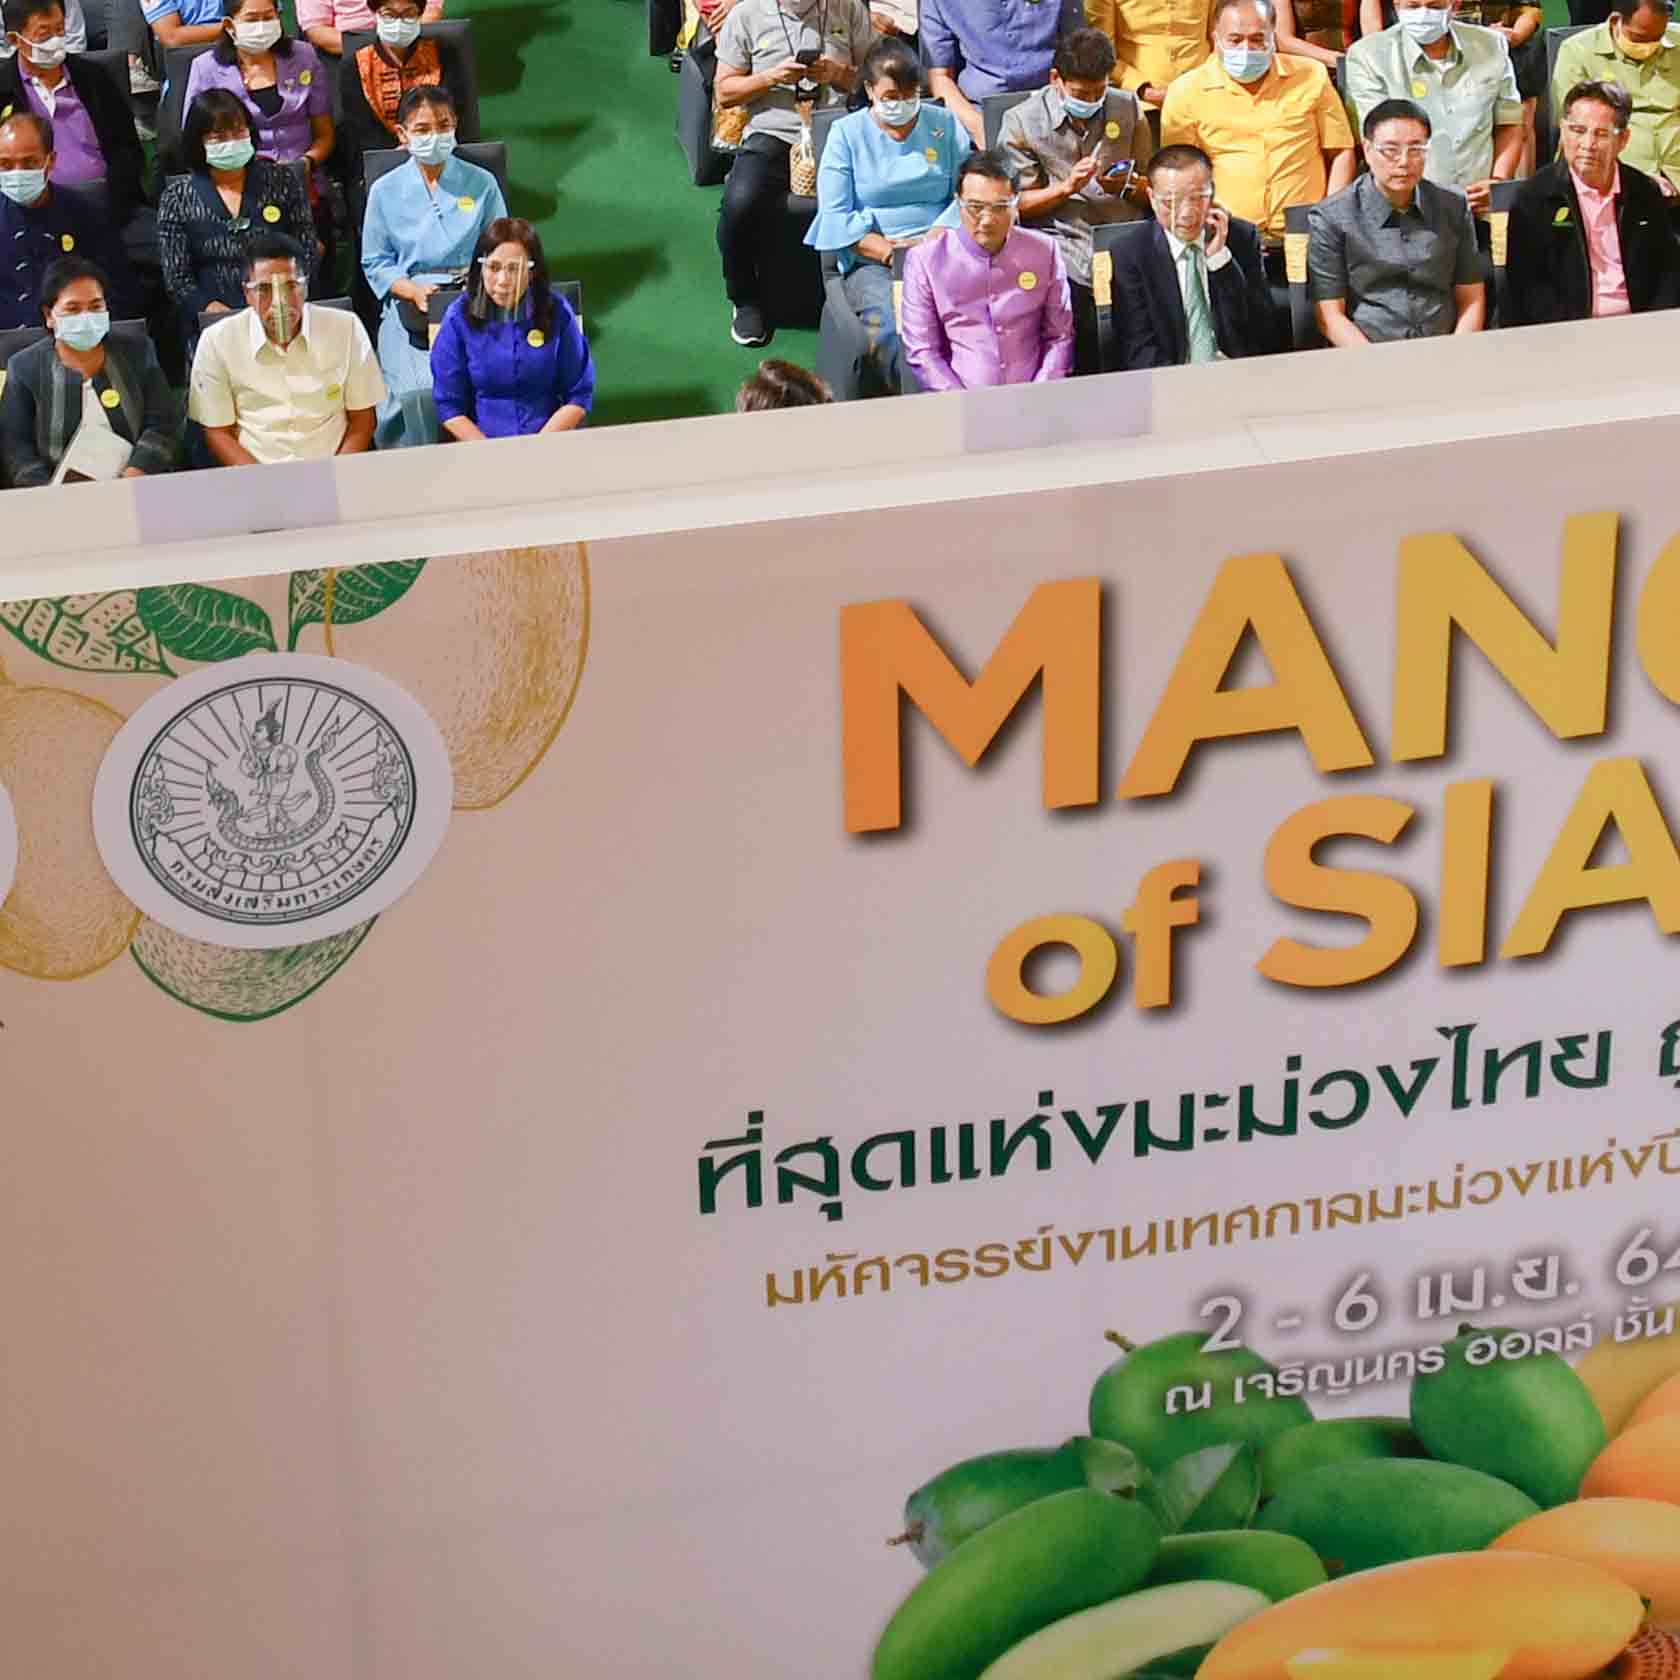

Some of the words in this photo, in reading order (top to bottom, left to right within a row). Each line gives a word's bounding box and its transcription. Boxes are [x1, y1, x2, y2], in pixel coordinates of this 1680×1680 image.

[985, 859, 1201, 1025] of
[694, 1022, 1614, 1223] ที่สุดแห่งมะม่วงไทย
[1164, 1383, 1211, 1415] ณ
[1231, 1338, 1446, 1404] เจริญนคร
[1464, 1311, 1594, 1366] ฮอลล์
[1613, 1296, 1674, 1344] ชั้น
[1197, 1293, 1243, 1355] 2
[1333, 1272, 1379, 1331] 6
[1417, 1253, 1580, 1320] เม.ย.
